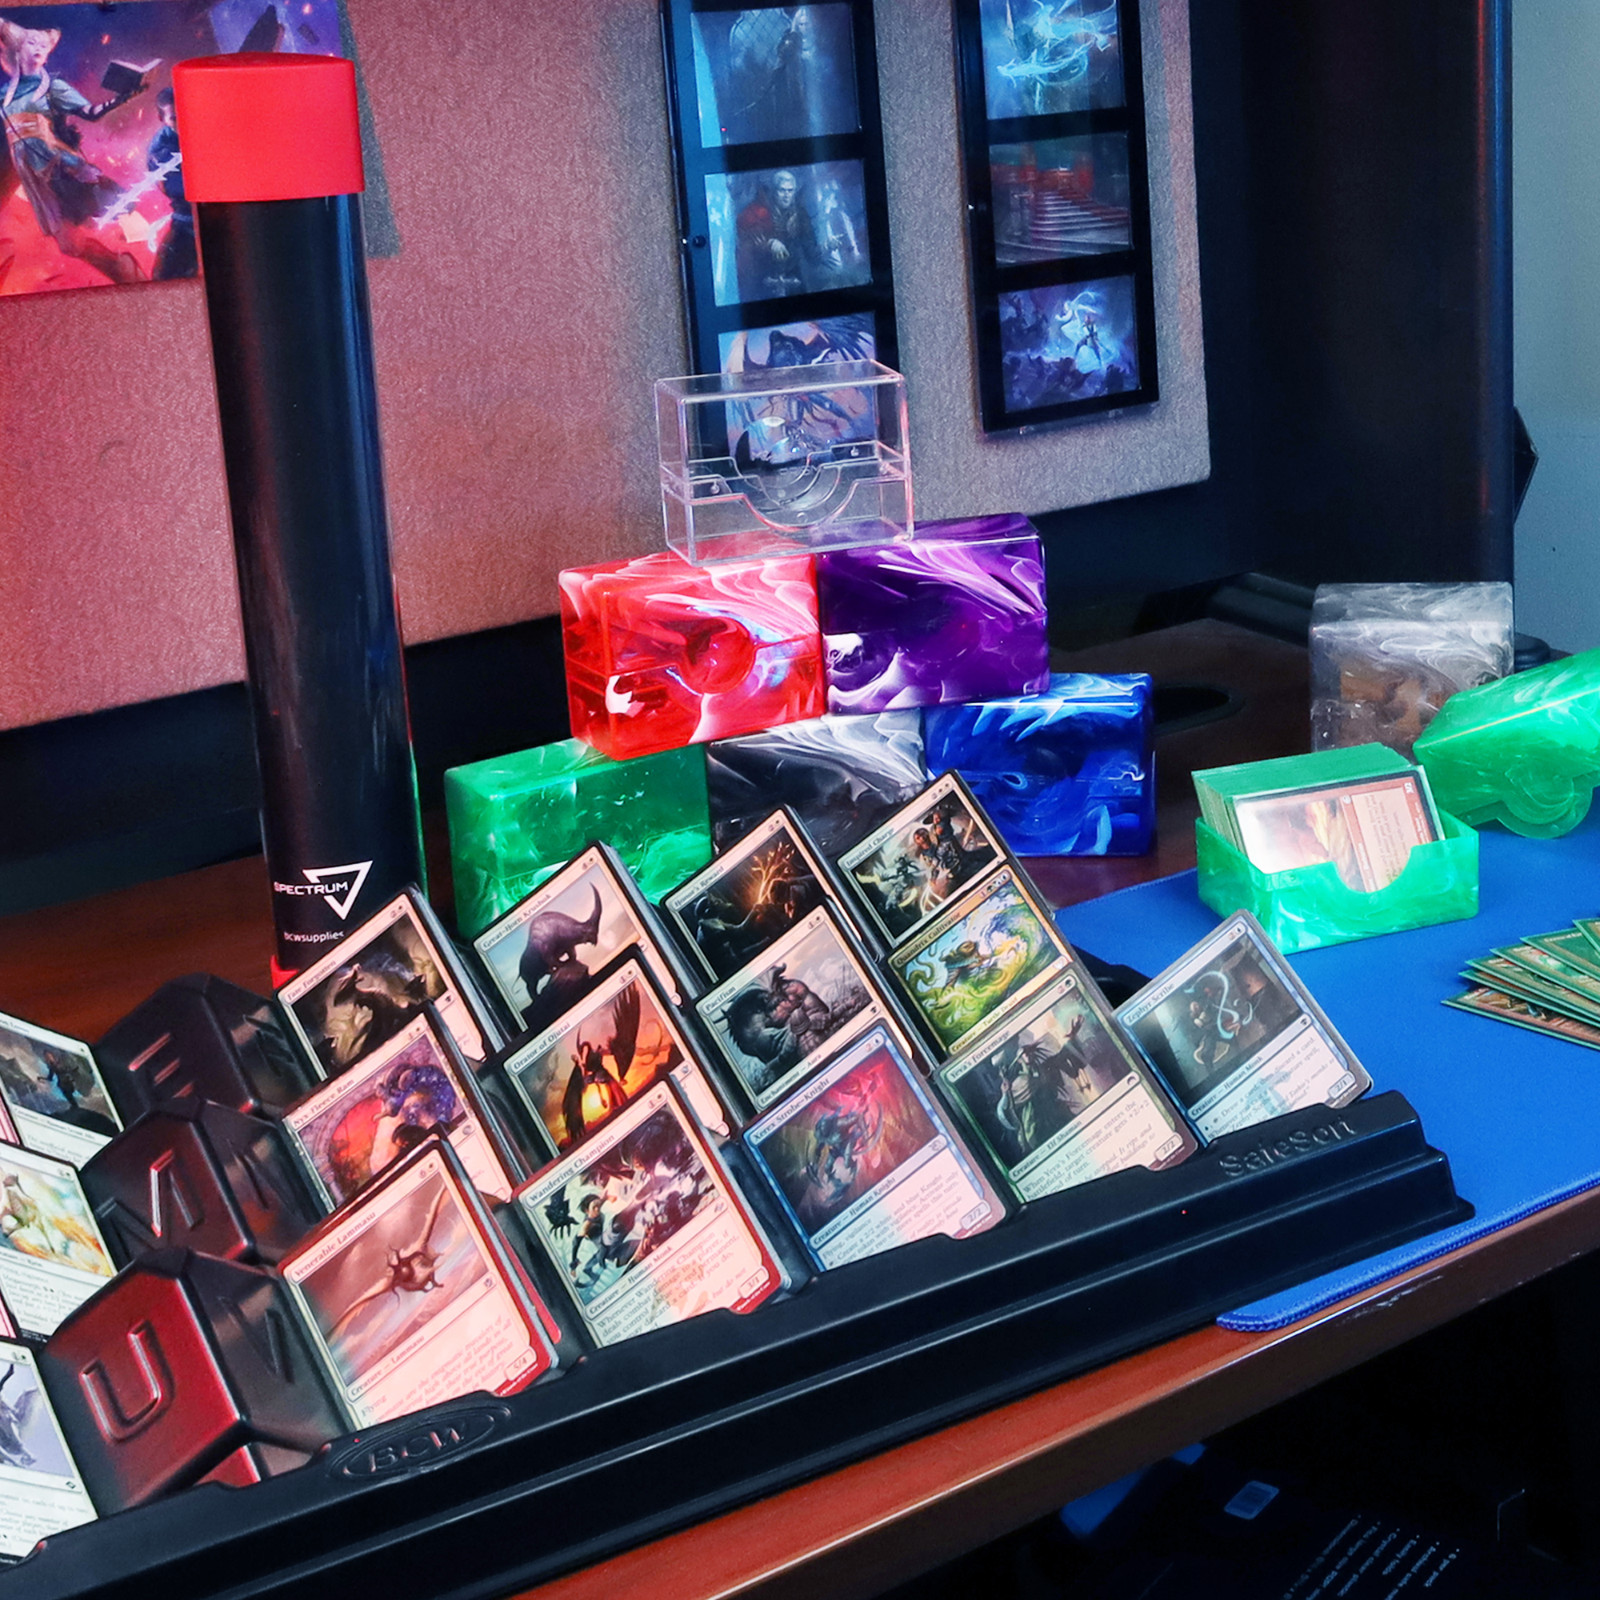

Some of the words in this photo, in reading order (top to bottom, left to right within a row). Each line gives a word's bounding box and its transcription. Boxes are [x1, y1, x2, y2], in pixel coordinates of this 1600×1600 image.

[846, 844, 872, 866] Inspired
[872, 826, 894, 845] Charge
[274, 881, 348, 895] SPECTRUM
[674, 885, 700, 906] Honor's
[700, 866, 724, 886] Reward
[896, 939, 928, 964] Quandrix
[928, 912, 961, 938] Cultivator
[302, 960, 337, 988] Forgotten
[705, 985, 735, 1010] Pacifism
[1126, 1001, 1152, 1023] Zephyr
[1151, 983, 1174, 1002] Scribe
[513, 1047, 538, 1068] Orator
[538, 1040, 547, 1049] of
[548, 1022, 570, 1042] Ojutai
[951, 1031, 976, 1051] Creature
[337, 1078, 353, 1093] Ram
[760, 1071, 800, 1103] Enchantment
[950, 1059, 972, 1078] Yeva's
[1191, 1094, 1216, 1115] Creature
[1224, 1070, 1245, 1088] Human
[1245, 1056, 1262, 1070] Monk
[753, 1121, 776, 1141] Xerex
[776, 1079, 830, 1122] Strobe-Knight
[1064, 1153, 1085, 1171] target
[1084, 1129, 1113, 1153] creature
[1113, 1118, 1128, 1132] gets
[1128, 1100, 1149, 1118] +2/+2
[529, 1165, 573, 1202] Wandering
[573, 1134, 614, 1168] Champion
[1012, 1154, 1040, 1177] Creature
[1047, 1140, 1057, 1150] Elf
[1056, 1120, 1081, 1141] Shaman
[1023, 1174, 1044, 1192] When
[1044, 1158, 1066, 1176] Yeva's
[1103, 1110, 1124, 1128] enters
[1124, 1100, 1136, 1111] the
[1162, 1141, 1175, 1153] 2/2
[1063, 1172, 1072, 1182] of
[813, 1219, 843, 1244] Creature
[849, 1194, 873, 1215] Human
[873, 1176, 896, 1196] Knight
[863, 1227, 874, 1238] 2/2
[892, 1203, 905, 1214] and
[968, 1208, 982, 1221] 2/2
[295, 1241, 335, 1276] Venerable
[337, 1210, 375, 1243] Lammasu
[589, 1289, 618, 1313] Creature
[628, 1262, 652, 1283] Human
[653, 1246, 671, 1262] Monk
[598, 1297, 635, 1328] Whenever
[635, 1265, 676, 1299] Wandering
[676, 1232, 715, 1266] Champion
[601, 1318, 621, 1336] deals
[622, 1295, 650, 1320] combat
[652, 1271, 681, 1296] damage
[644, 1301, 670, 1324] discard
[706, 1262, 719, 1276] you
[606, 1331, 621, 1345] you
[622, 1309, 648, 1332] control
[655, 1288, 672, 1304] blue
[682, 1270, 694, 1282] red
[80, 1320, 175, 1446] U
[351, 1368, 381, 1395] Creature
[391, 1335, 424, 1364] Lammasu
[362, 1393, 386, 1416] Flying
[369, 1421, 466, 1472] BCW
